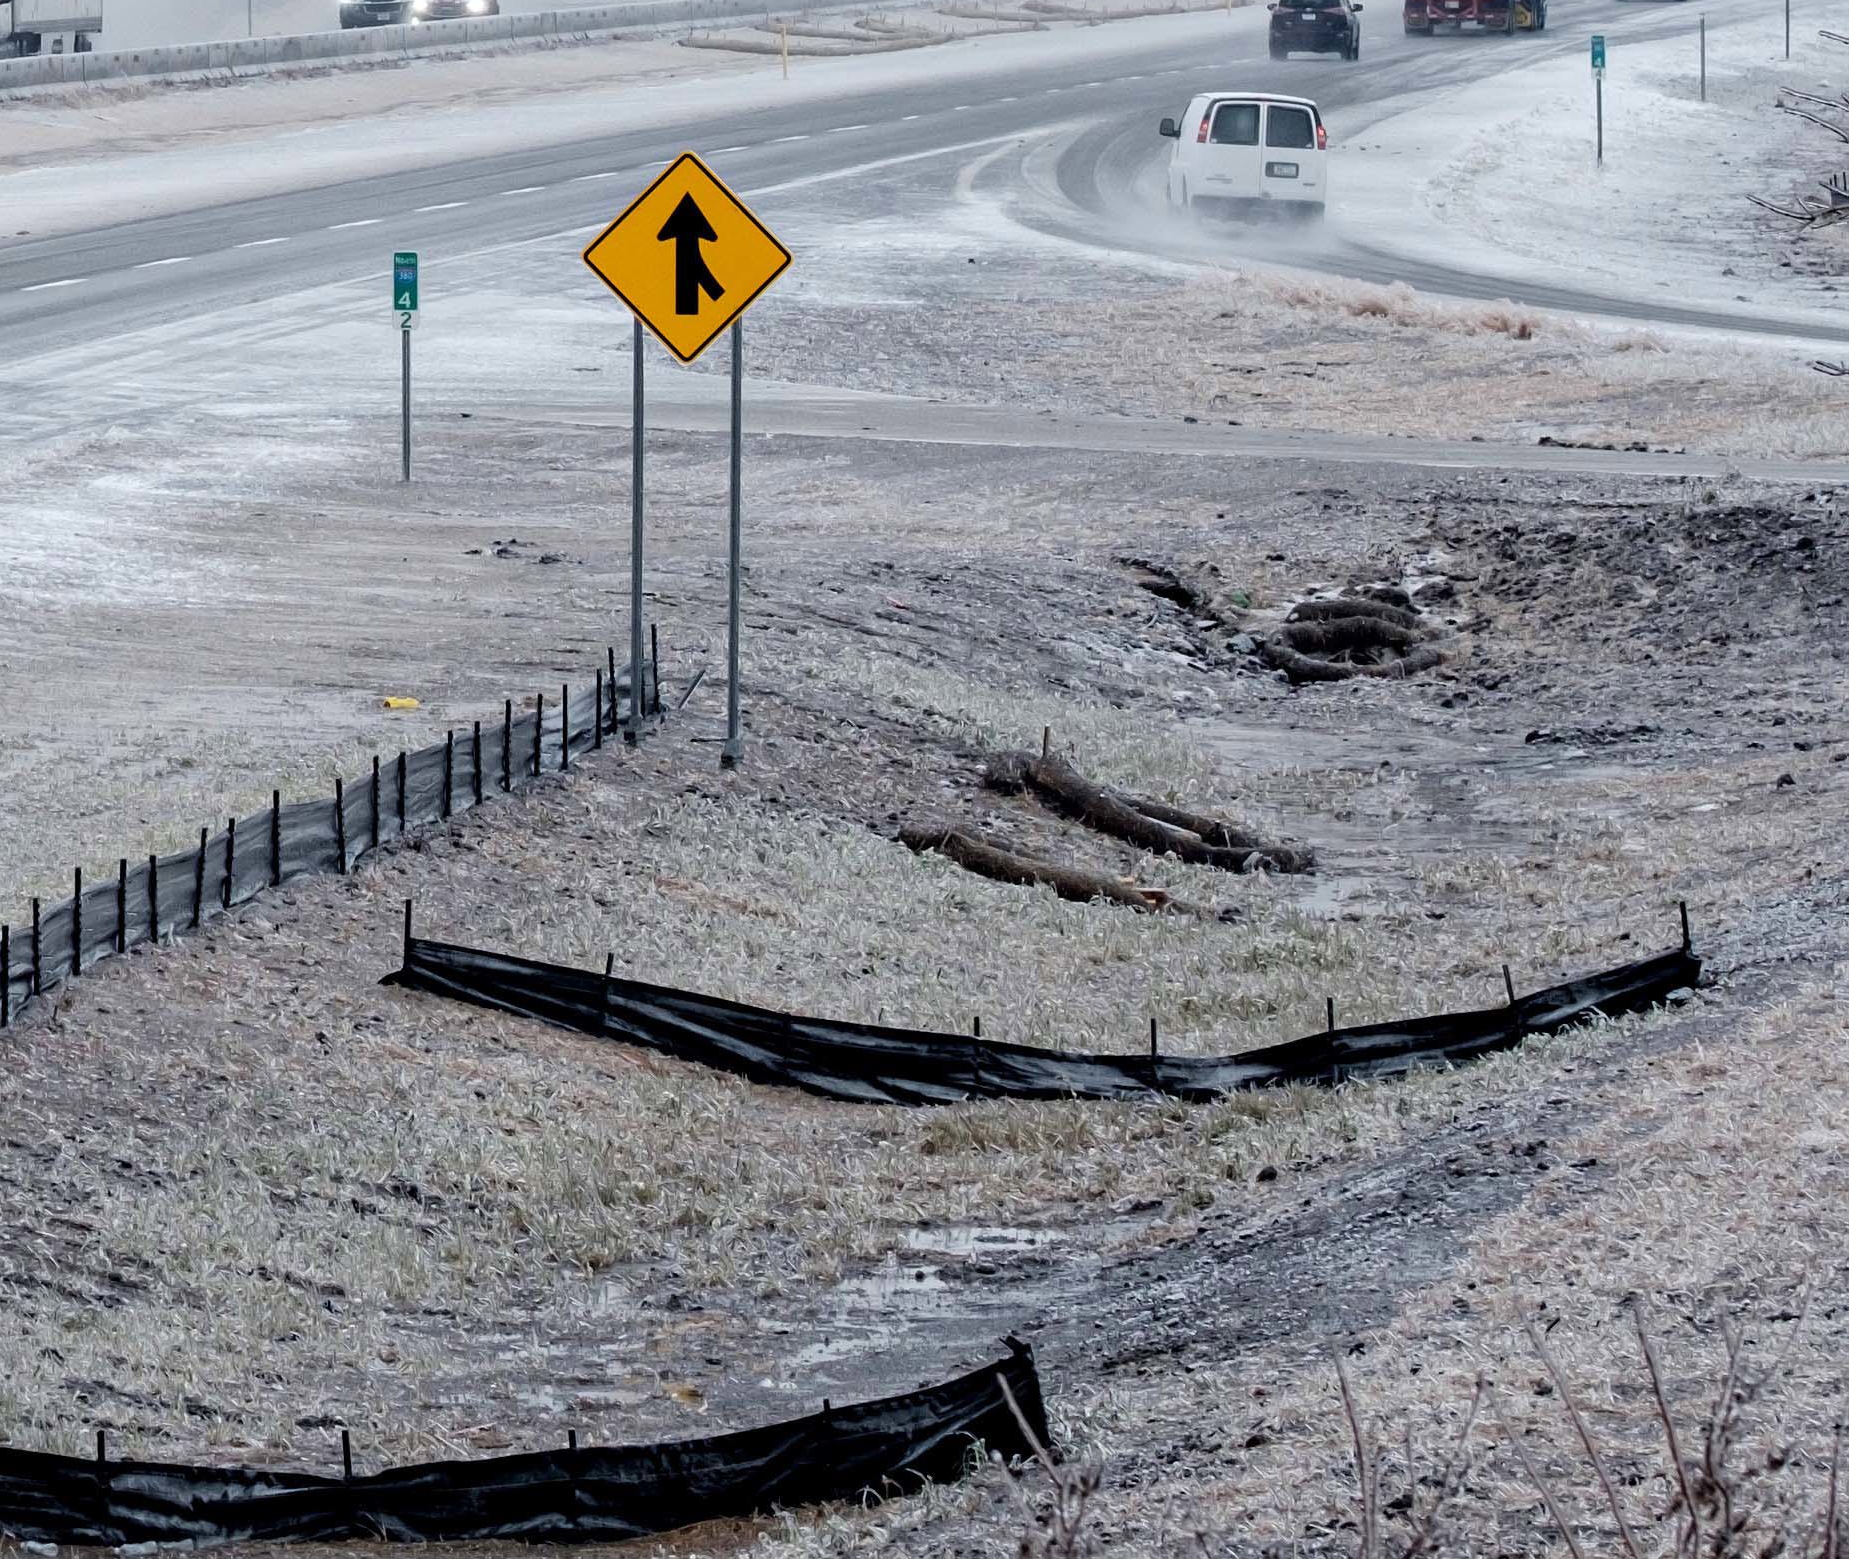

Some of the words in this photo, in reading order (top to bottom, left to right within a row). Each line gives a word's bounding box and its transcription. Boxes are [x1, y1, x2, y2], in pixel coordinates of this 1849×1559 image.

[398, 271, 414, 280] 380
[398, 291, 411, 308] 4
[400, 311, 412, 329] 2
